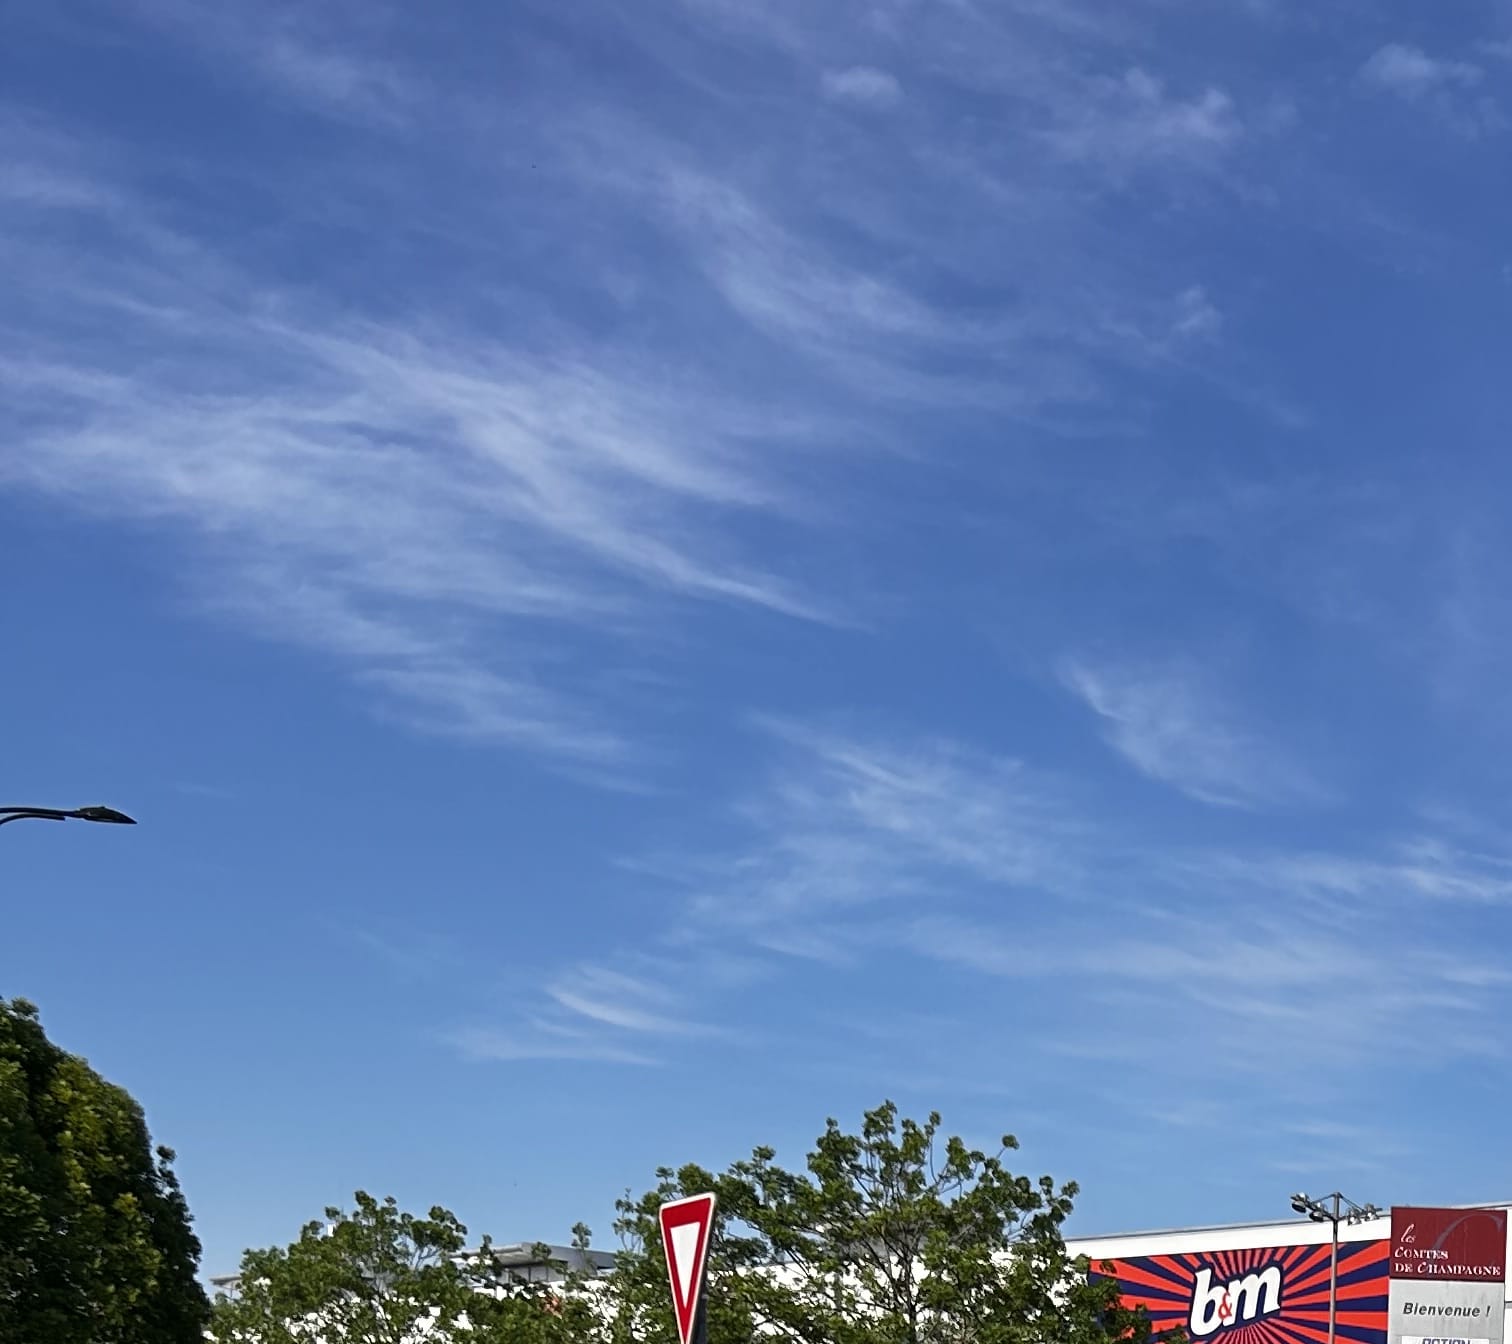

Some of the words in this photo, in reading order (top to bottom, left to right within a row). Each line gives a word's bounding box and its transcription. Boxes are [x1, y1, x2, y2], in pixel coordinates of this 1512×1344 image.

[1394, 1263, 1413, 1273] DE
[1417, 1261, 1501, 1277] CHAMPAGNE
[1402, 1302, 1480, 1318] Bienvenue
